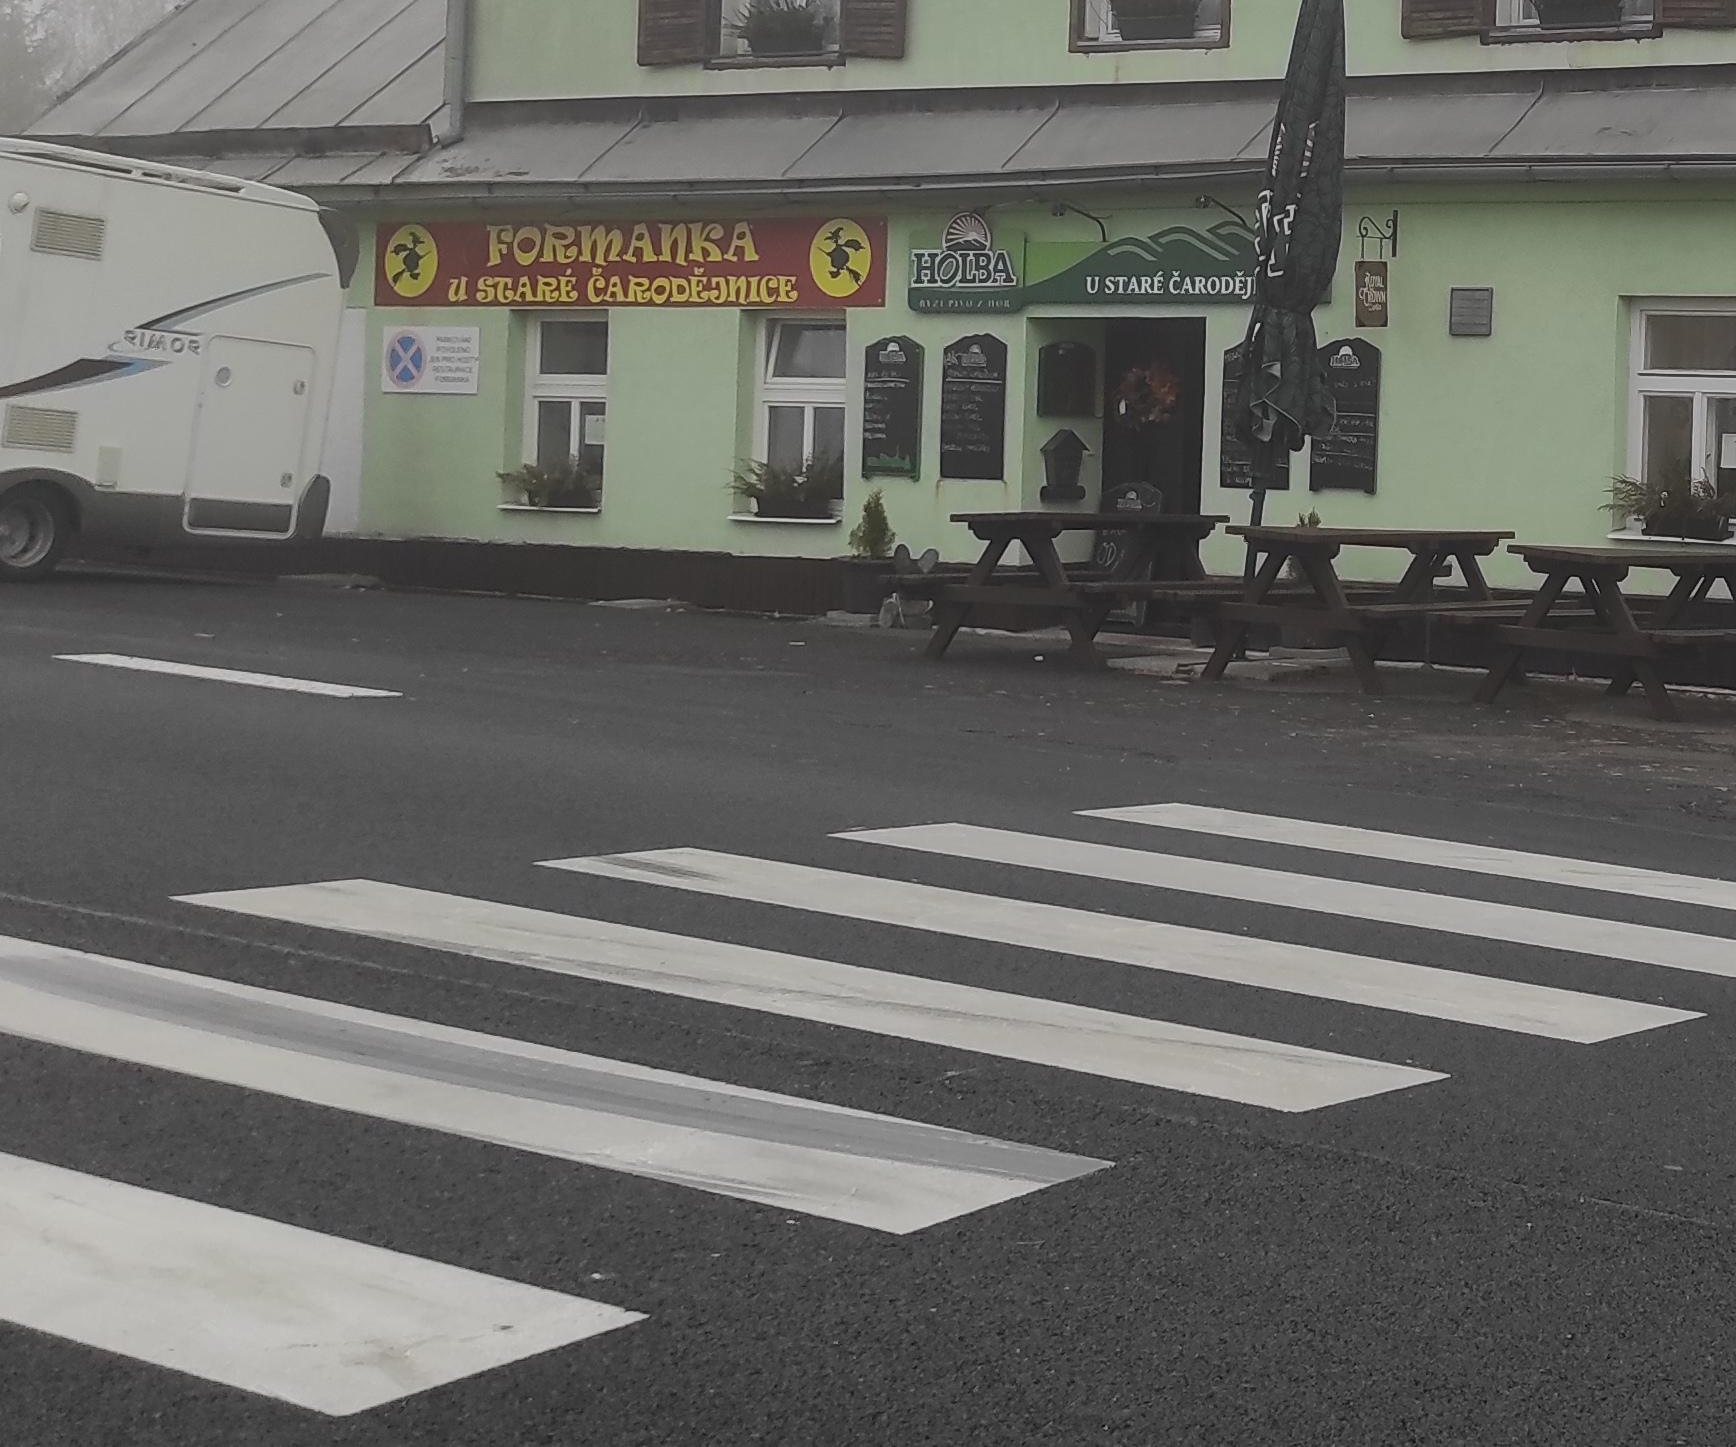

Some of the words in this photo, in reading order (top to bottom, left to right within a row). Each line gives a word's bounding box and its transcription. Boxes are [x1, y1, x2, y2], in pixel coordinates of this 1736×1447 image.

[487, 222, 760, 267] FORMANKA
[448, 275, 469, 303] U
[476, 268, 579, 303] STARÉ
[587, 267, 799, 304] ČARODĚJNICE
[911, 249, 1017, 288] HOLBA
[1086, 276, 1100, 294] U
[1104, 271, 1163, 294] STARÉ
[123, 330, 201, 356] RIMOR
